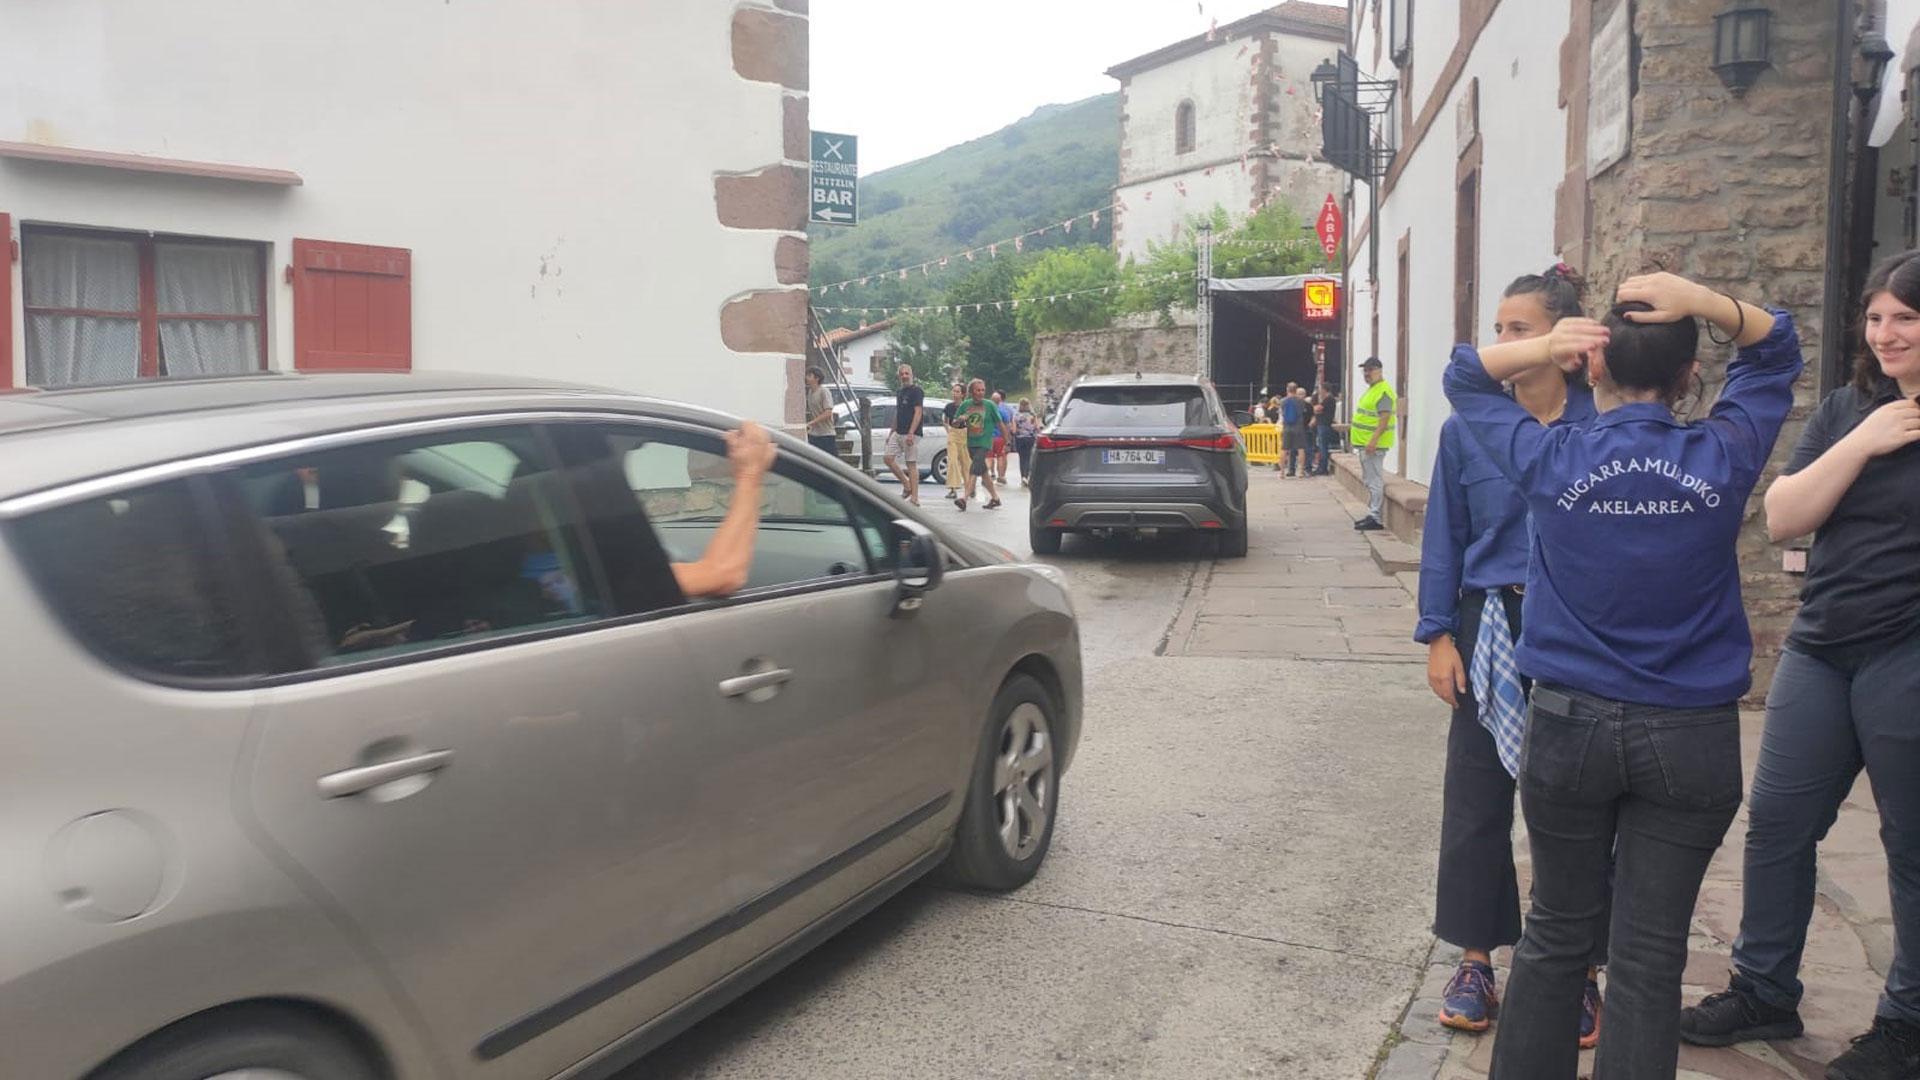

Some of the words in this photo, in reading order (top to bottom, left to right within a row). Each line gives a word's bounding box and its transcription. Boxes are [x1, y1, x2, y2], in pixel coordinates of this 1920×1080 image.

[814, 188, 853, 206] BAR
[1325, 202, 1335, 254] TABAC
[1589, 500, 1694, 515] AKELARREA
